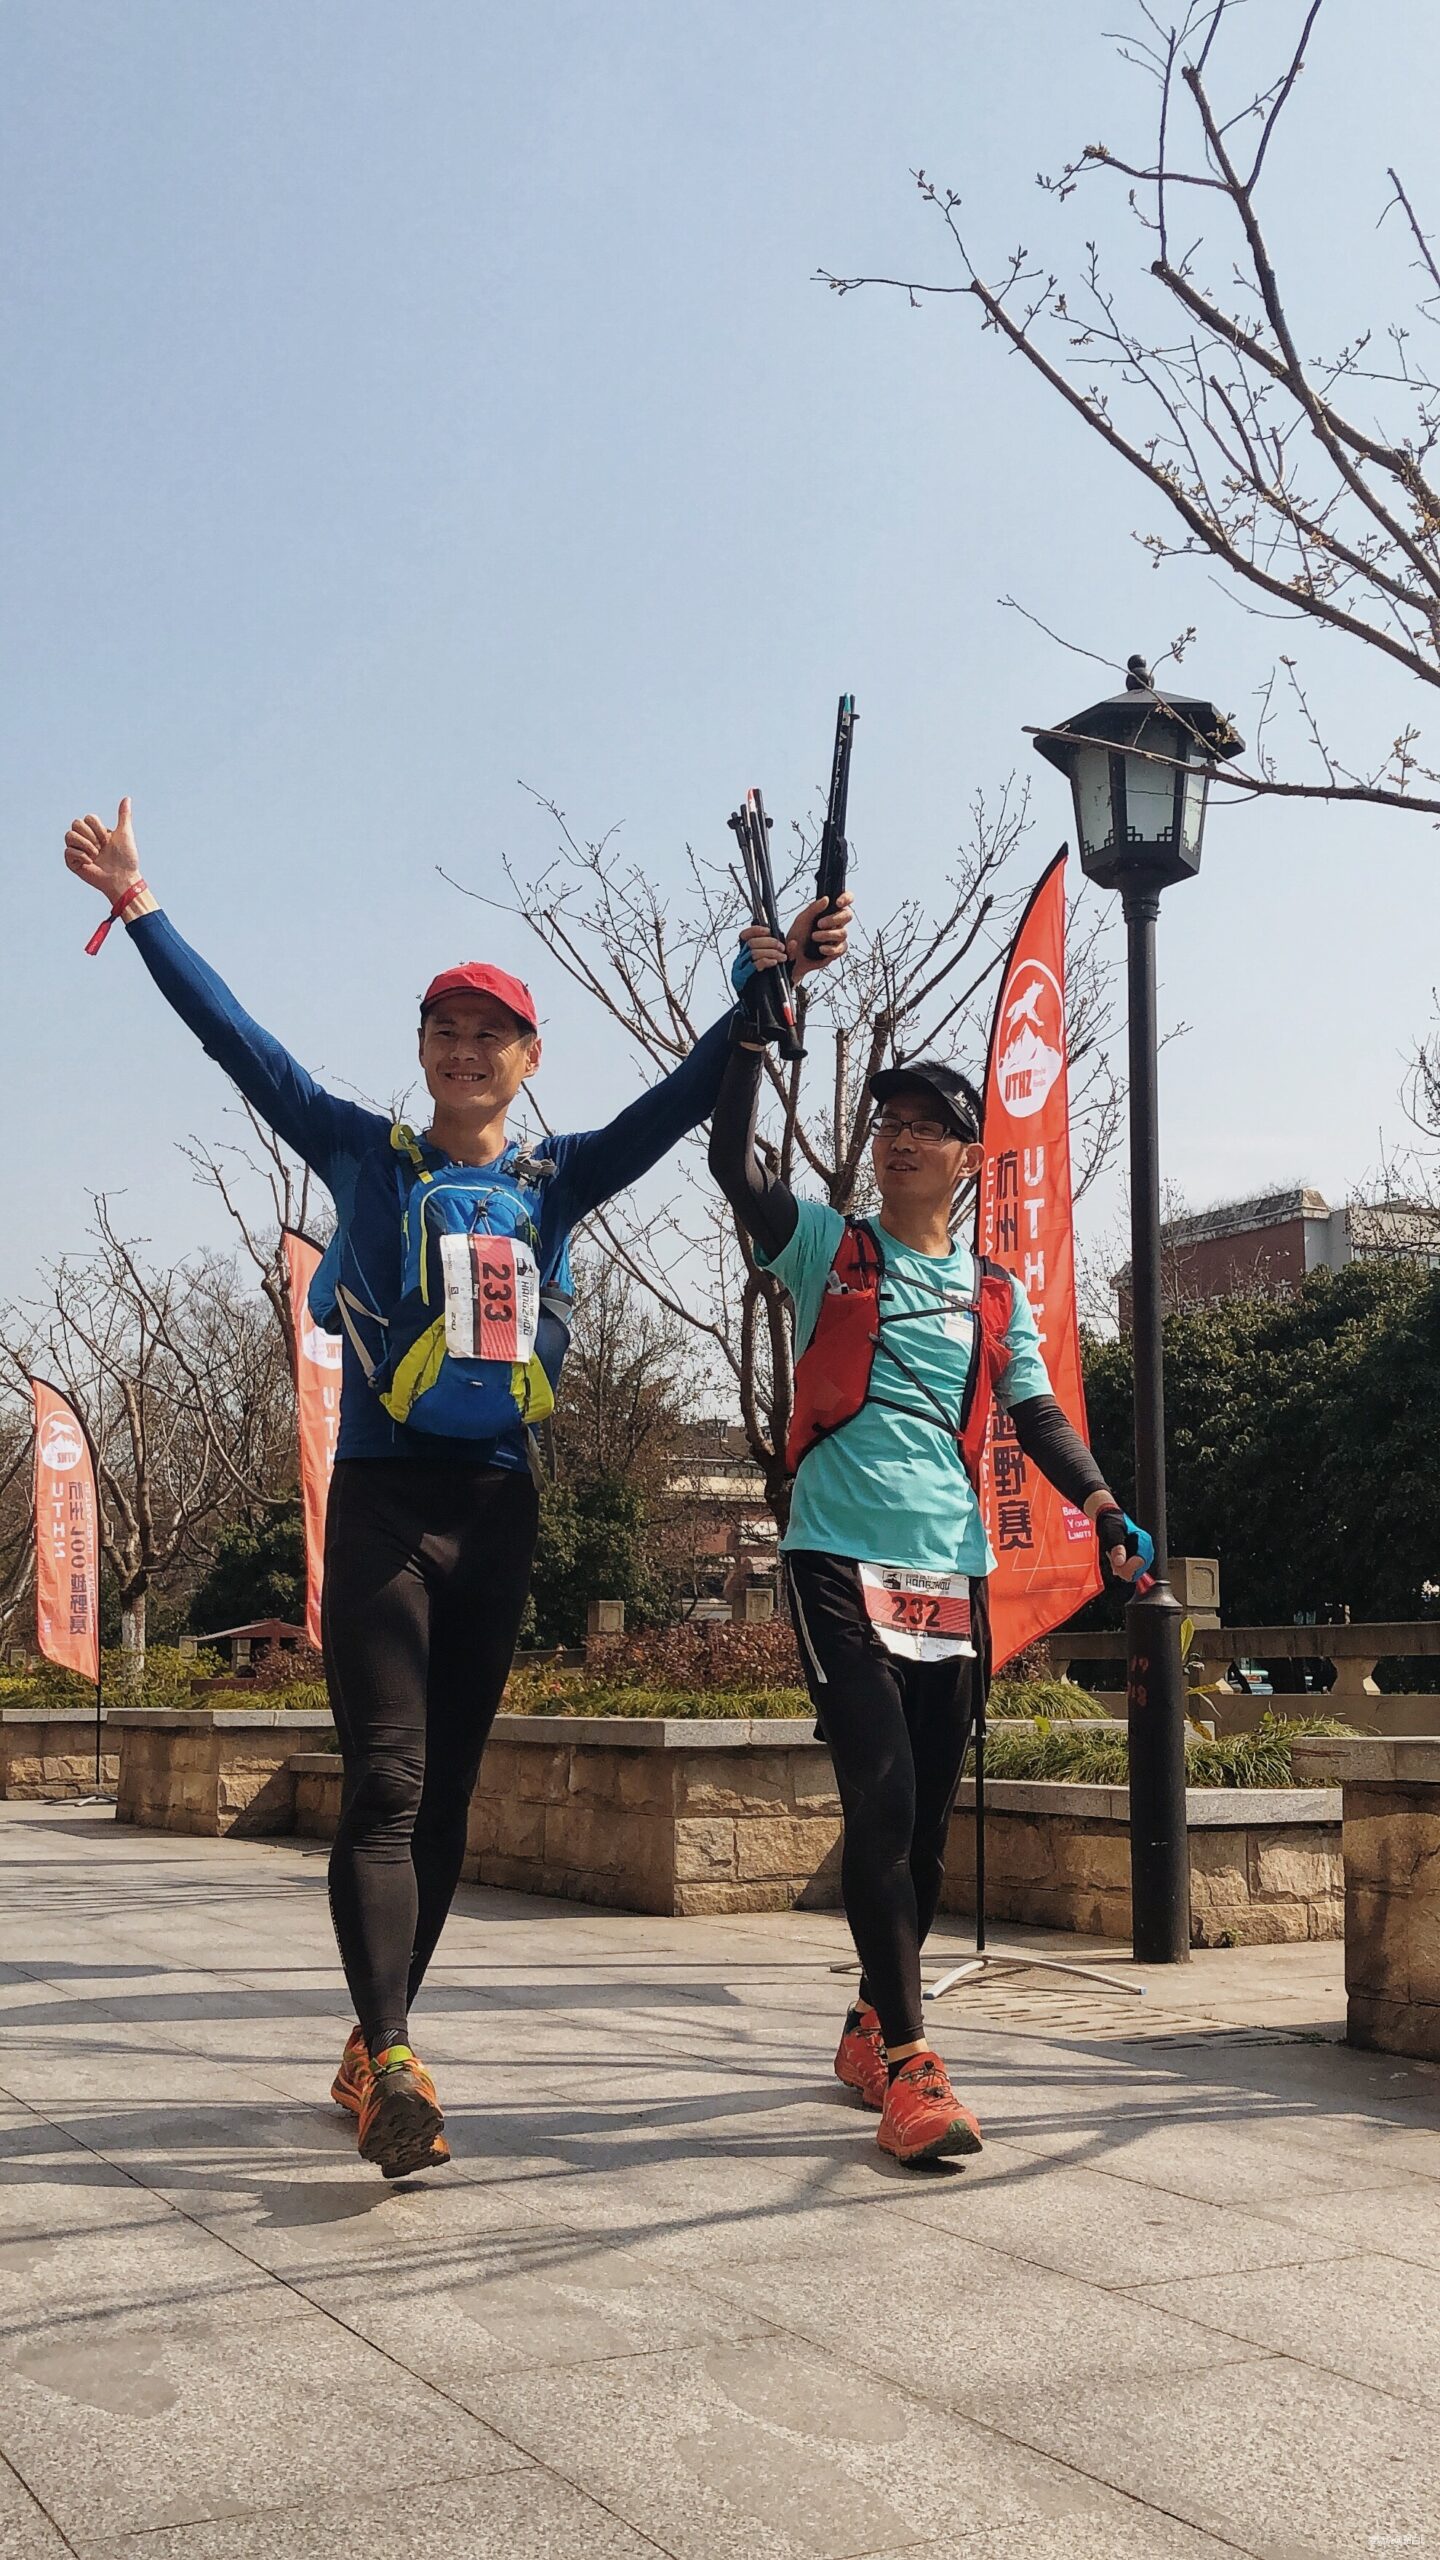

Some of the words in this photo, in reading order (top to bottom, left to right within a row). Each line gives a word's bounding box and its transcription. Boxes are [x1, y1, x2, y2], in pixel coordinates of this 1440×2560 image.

[1005, 1068, 1032, 1102] UTHZ
[985, 1156, 995, 1257] ULTRA
[482, 1262, 513, 1322] 233
[891, 1597, 941, 1627] 232
